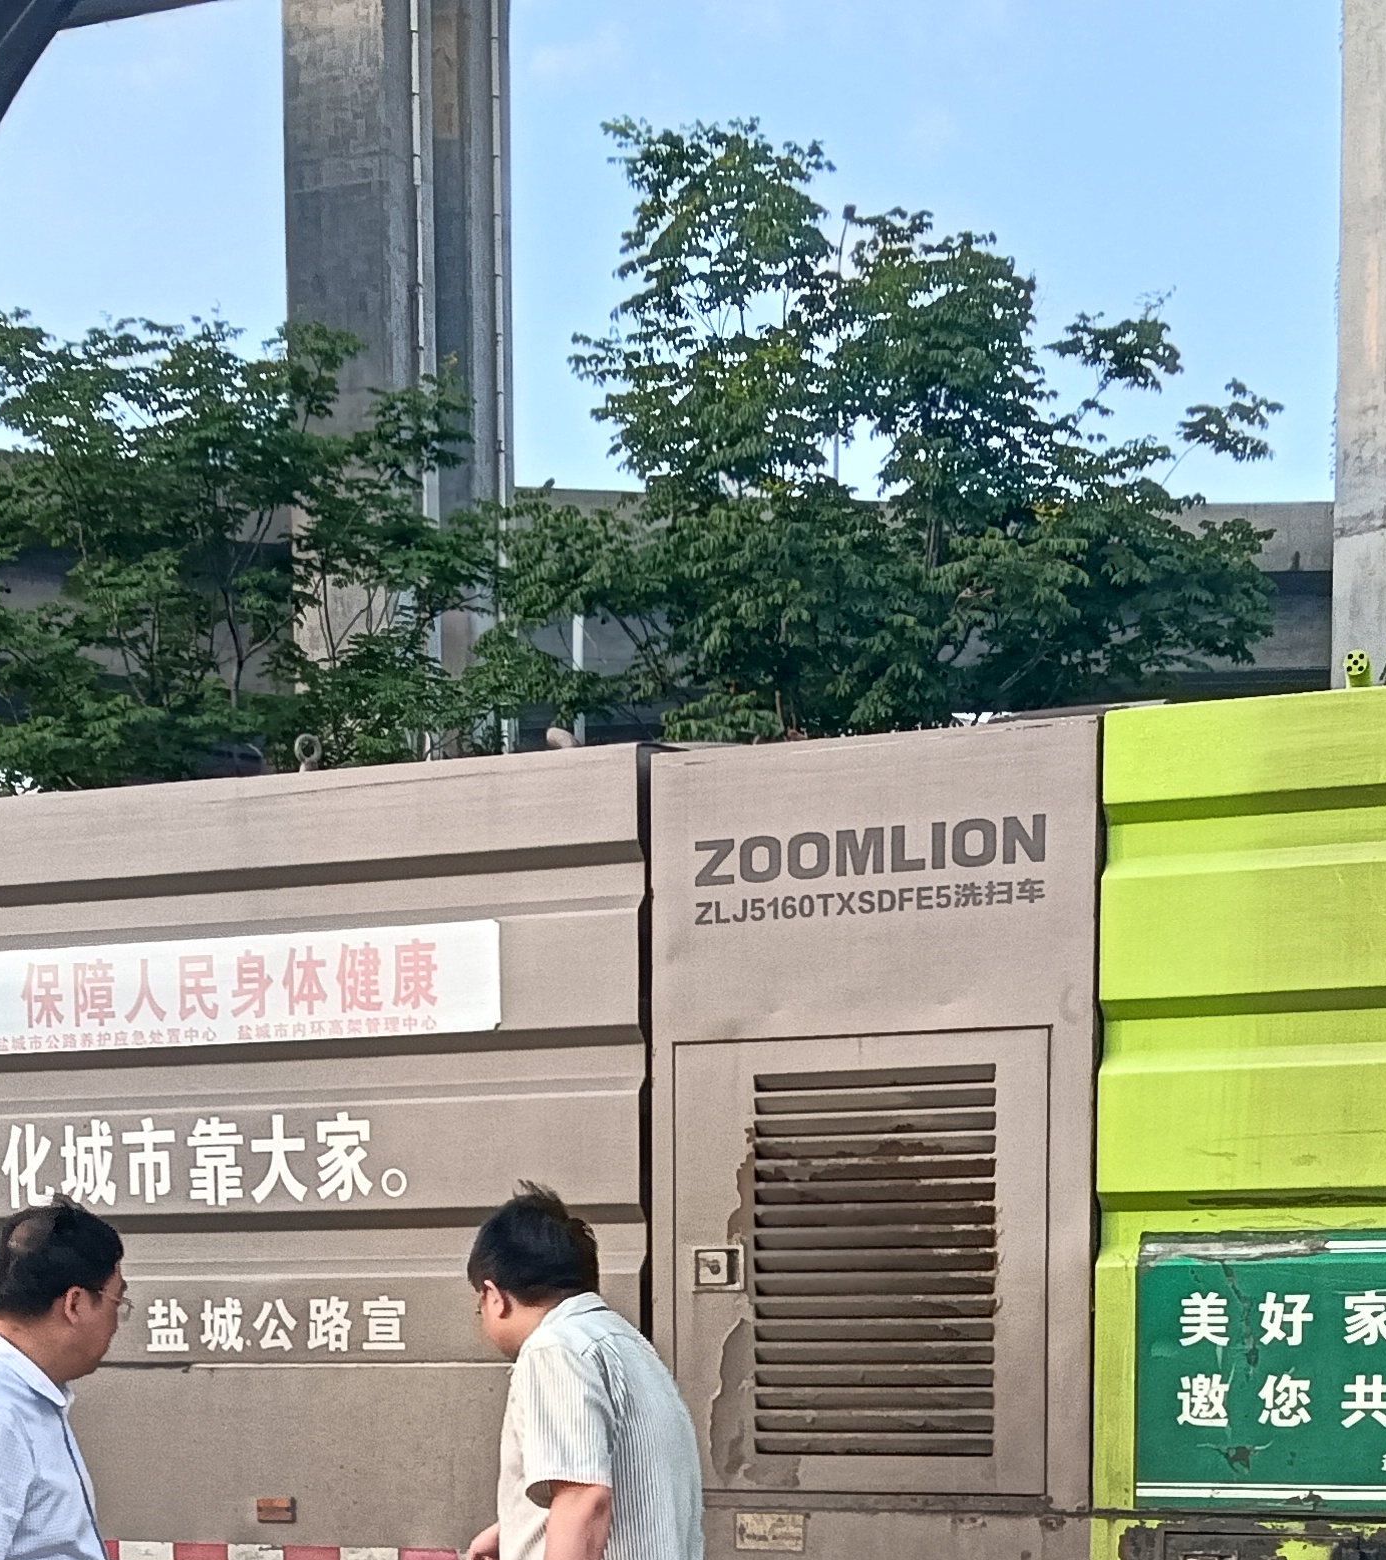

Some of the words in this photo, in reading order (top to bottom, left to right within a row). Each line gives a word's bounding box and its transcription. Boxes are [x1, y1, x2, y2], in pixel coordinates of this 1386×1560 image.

[693, 814, 1047, 887] ZOOMLION
[693, 879, 1046, 926] ZLJ5160TXSDFE5洗扫车
[21, 939, 440, 1029] 保障人民身体健康
[146, 1295, 407, 1352] 盐城公路宣
